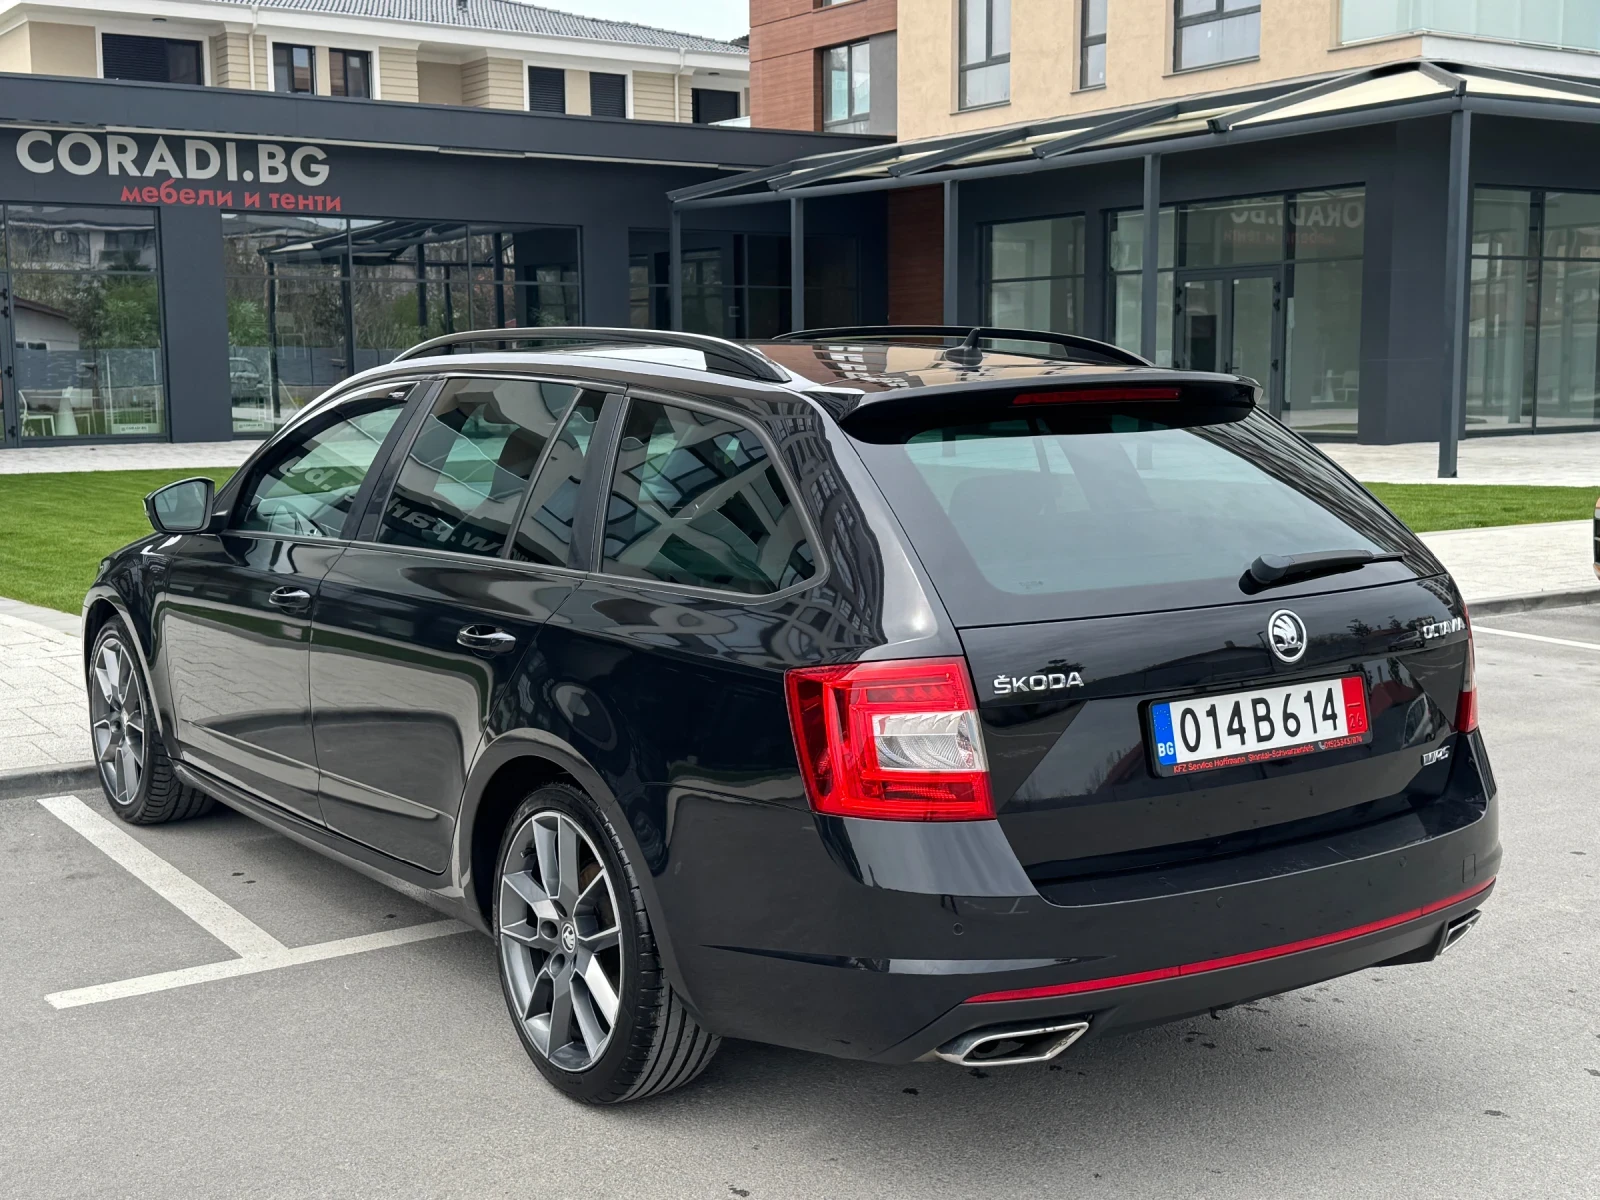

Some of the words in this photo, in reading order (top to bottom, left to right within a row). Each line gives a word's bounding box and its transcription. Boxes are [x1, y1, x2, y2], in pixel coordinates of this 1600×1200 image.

[16, 130, 330, 186] CORADI.BG
[120, 178, 233, 207] мебели
[244, 191, 260, 207] и
[269, 192, 341, 212] тенти
[993, 671, 1085, 694] ŠKODA
[1180, 687, 1338, 753] 014B614
[1158, 742, 1174, 757] BG
[1188, 756, 1213, 771] Service
